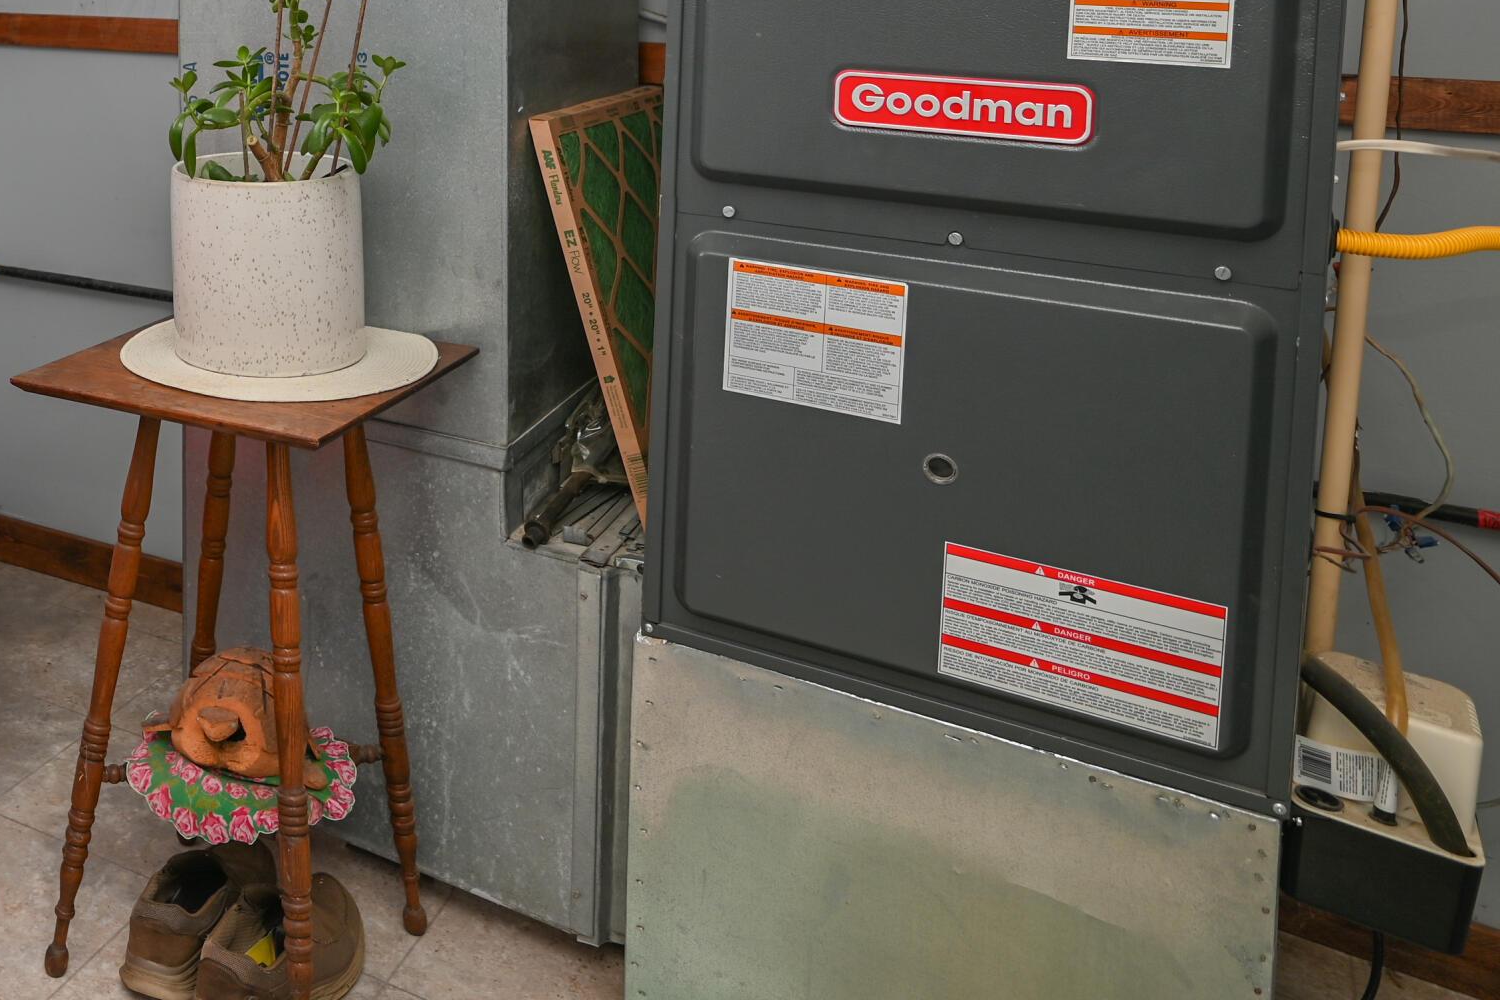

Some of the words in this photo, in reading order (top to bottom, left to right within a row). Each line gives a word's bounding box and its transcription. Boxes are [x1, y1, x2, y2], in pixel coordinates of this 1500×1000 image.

[1141, 0, 1177, 8] WARNING
[1128, 27, 1188, 38] AVERTISSEMENT
[851, 82, 1073, 129] Goodman
[563, 229, 578, 248] EZ
[569, 250, 583, 275] Flow
[1057, 570, 1095, 587] DANGER
[946, 573, 969, 584] CARBON
[1001, 587, 1033, 600] POISONING
[1033, 595, 1057, 606] HAZARD
[1053, 626, 1091, 643] DANGER
[1051, 663, 1090, 681] PELIGRO
